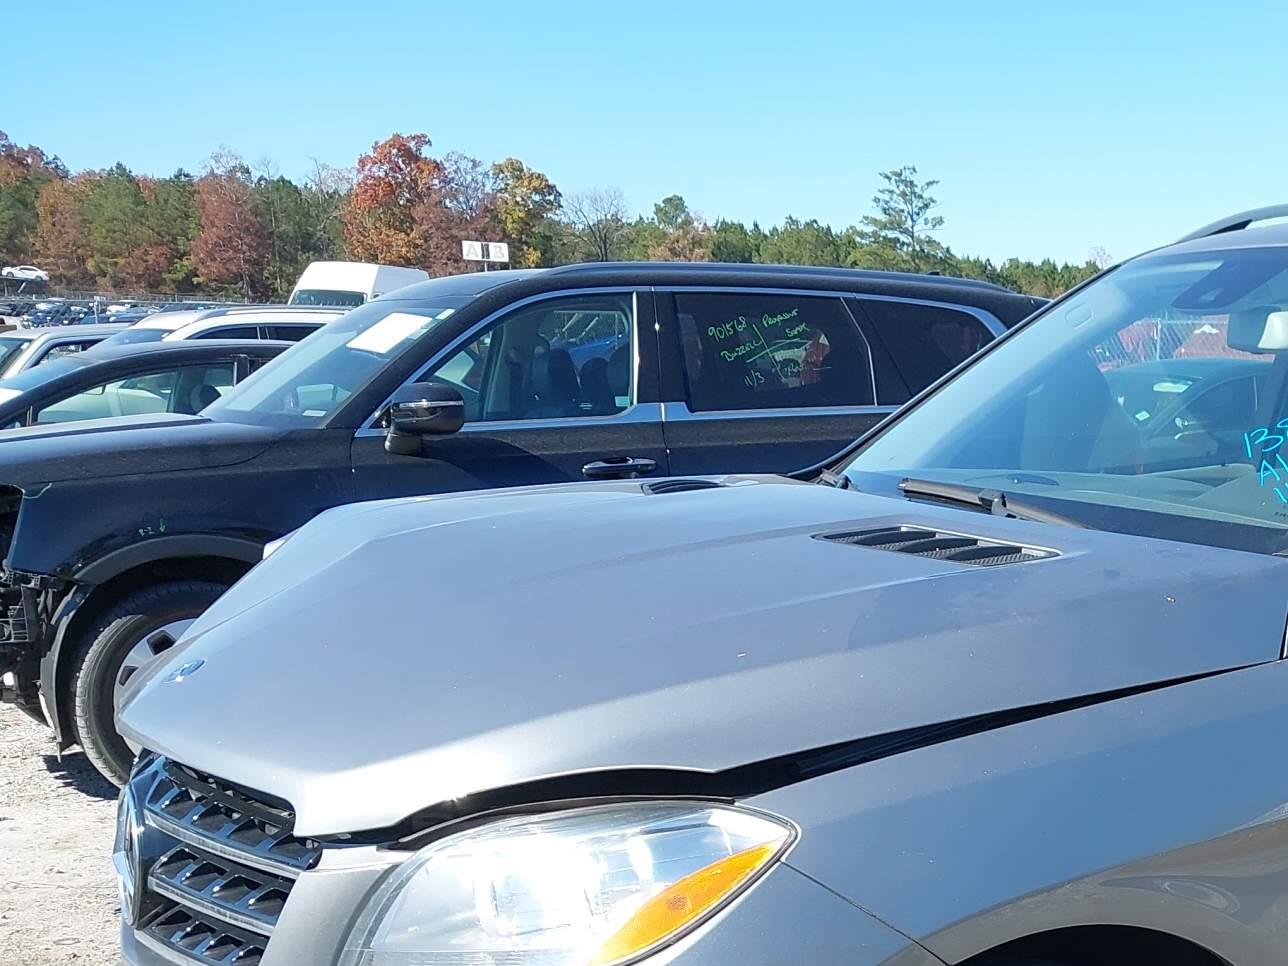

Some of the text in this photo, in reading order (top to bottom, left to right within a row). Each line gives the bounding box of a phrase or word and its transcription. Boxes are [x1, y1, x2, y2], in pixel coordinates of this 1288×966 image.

[466, 243, 480, 258] A
[708, 316, 746, 343] 901568
[744, 369, 765, 388] 11/3
